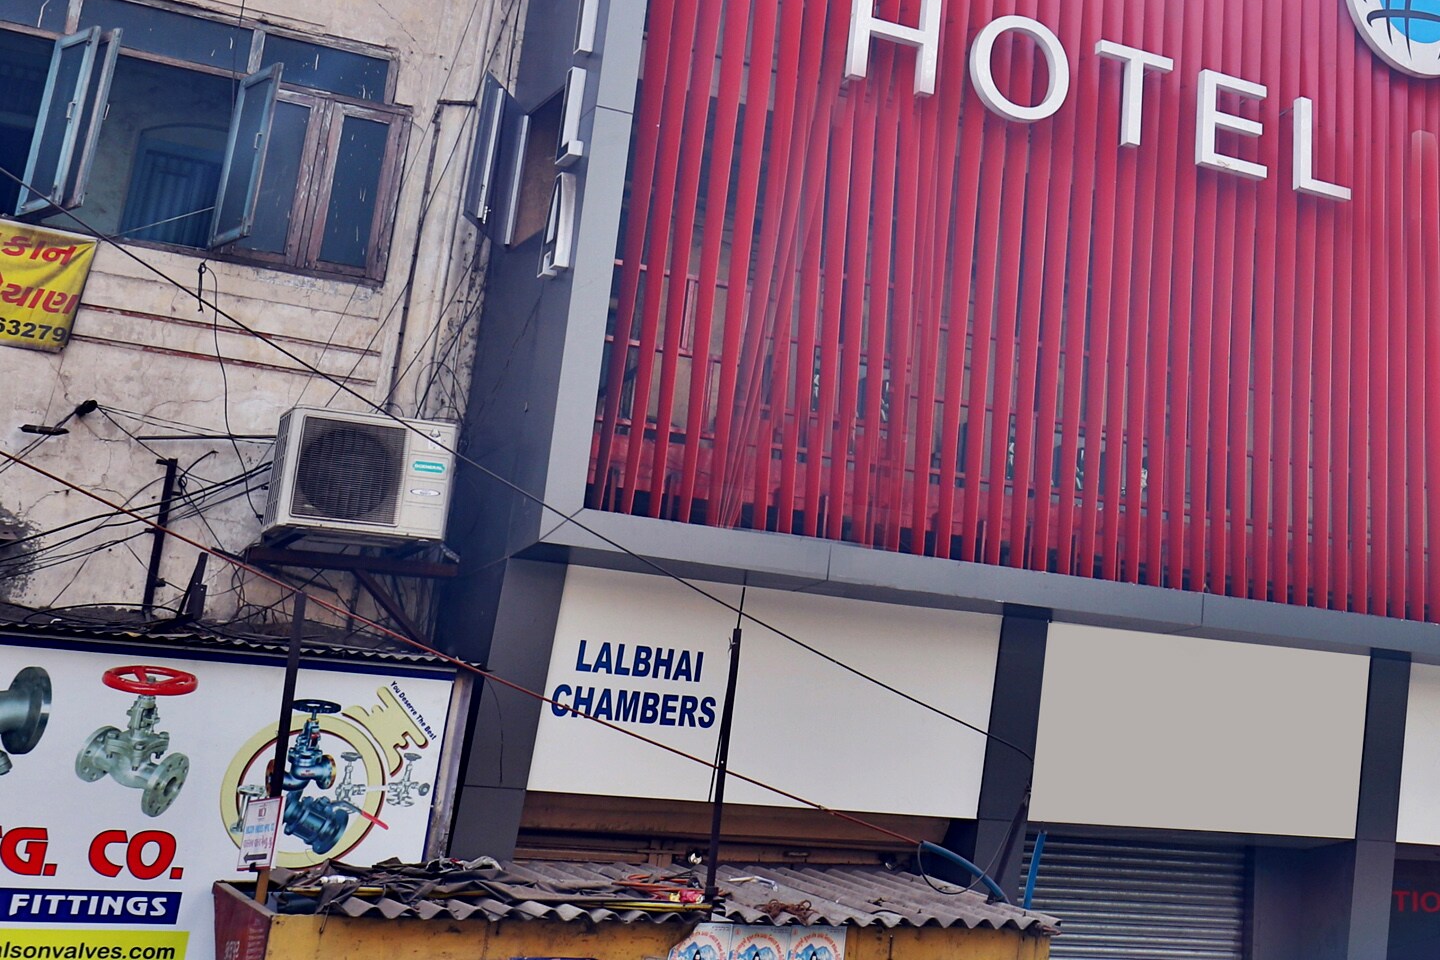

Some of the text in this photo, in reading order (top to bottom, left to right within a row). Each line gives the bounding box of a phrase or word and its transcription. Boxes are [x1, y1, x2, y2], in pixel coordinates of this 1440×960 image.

[0, 233, 77, 266] કાન
[0, 271, 80, 315] ચાણ
[576, 640, 704, 682] LALBHAI
[391, 681, 437, 740] You Deserve The Best
[551, 684, 717, 729] CHAMBERS
[0, 825, 184, 880] G. CO.
[8, 893, 168, 917] FITTINGS
[0, 941, 175, 959] lsonvalves.com
